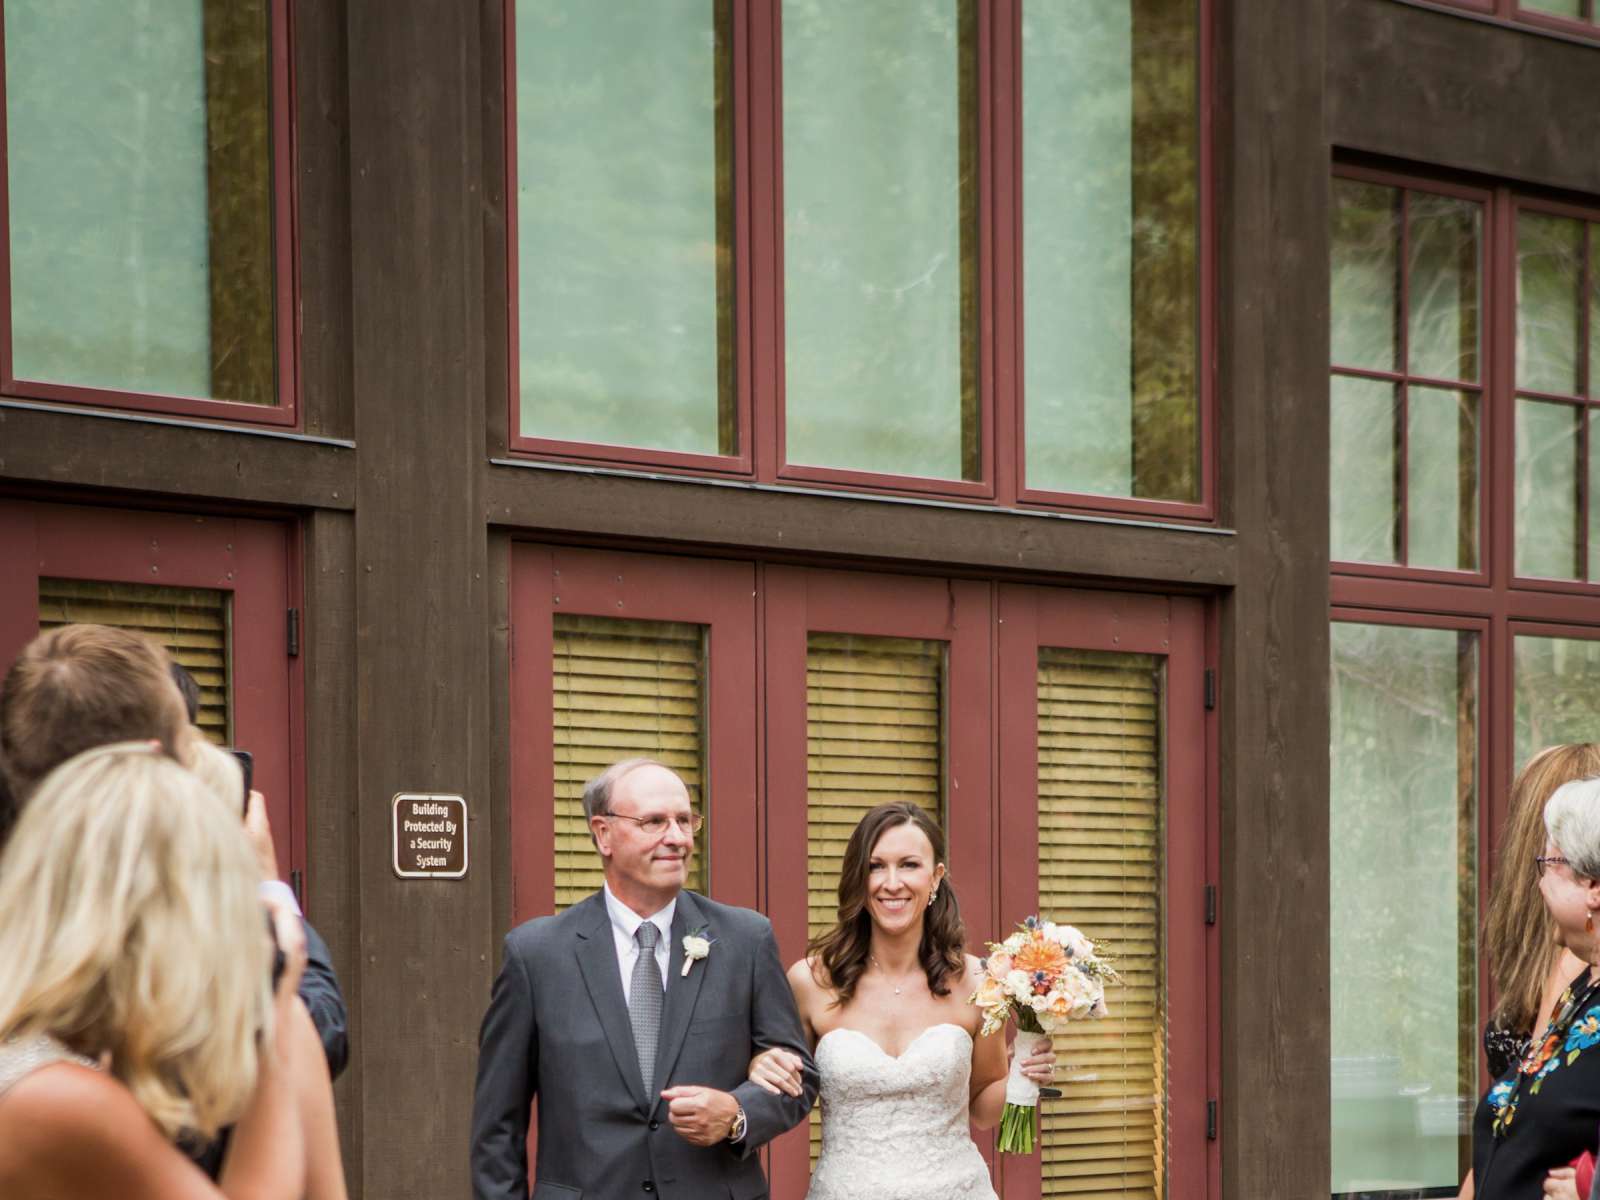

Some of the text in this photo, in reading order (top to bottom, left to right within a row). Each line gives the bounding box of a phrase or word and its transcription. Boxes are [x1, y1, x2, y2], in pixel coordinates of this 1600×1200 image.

[412, 803, 448, 818] Building
[404, 820, 457, 835] Protected By
[410, 837, 452, 852] a Security
[416, 854, 447, 869] System
